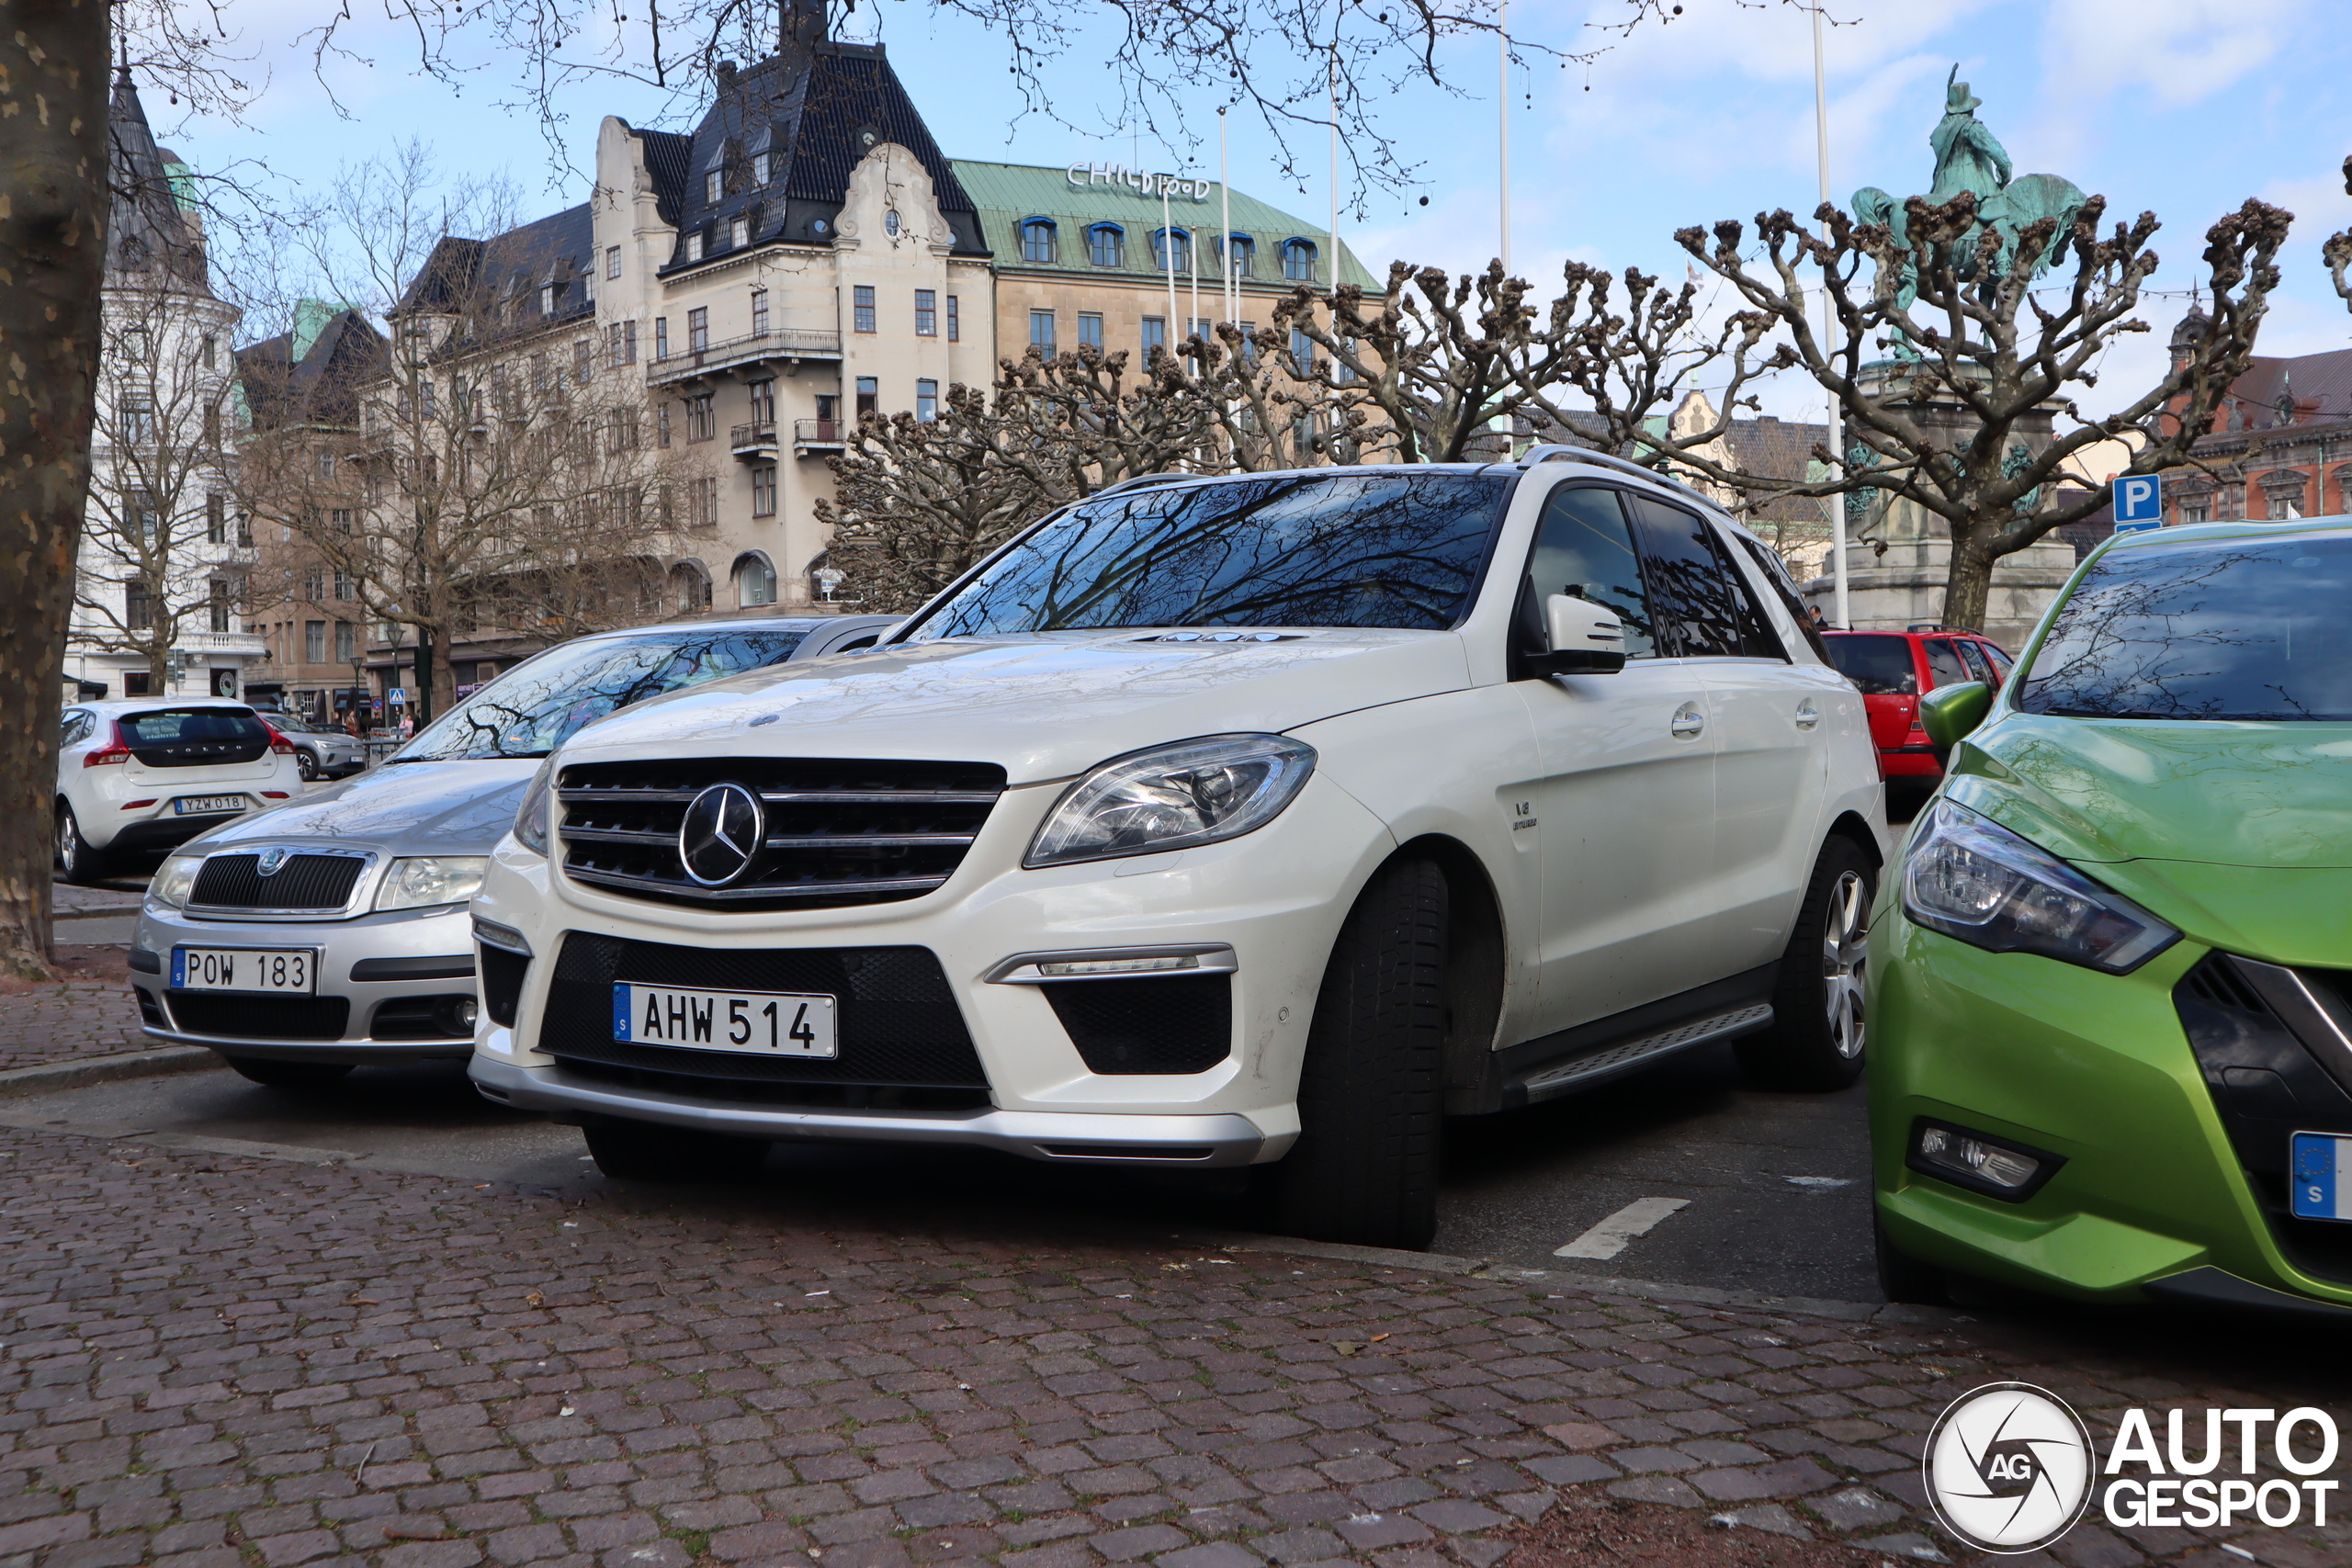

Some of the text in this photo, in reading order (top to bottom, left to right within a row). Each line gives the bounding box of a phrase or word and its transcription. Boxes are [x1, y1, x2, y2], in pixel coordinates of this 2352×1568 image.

[2126, 479, 2152, 517] P
[166, 745, 242, 753] VOLVO
[186, 796, 240, 810] YZW 018
[1516, 800, 1530, 816] V8
[175, 953, 304, 987] S POW 183
[619, 993, 815, 1049] S AHW 514
[2308, 1186, 2323, 1203] S
